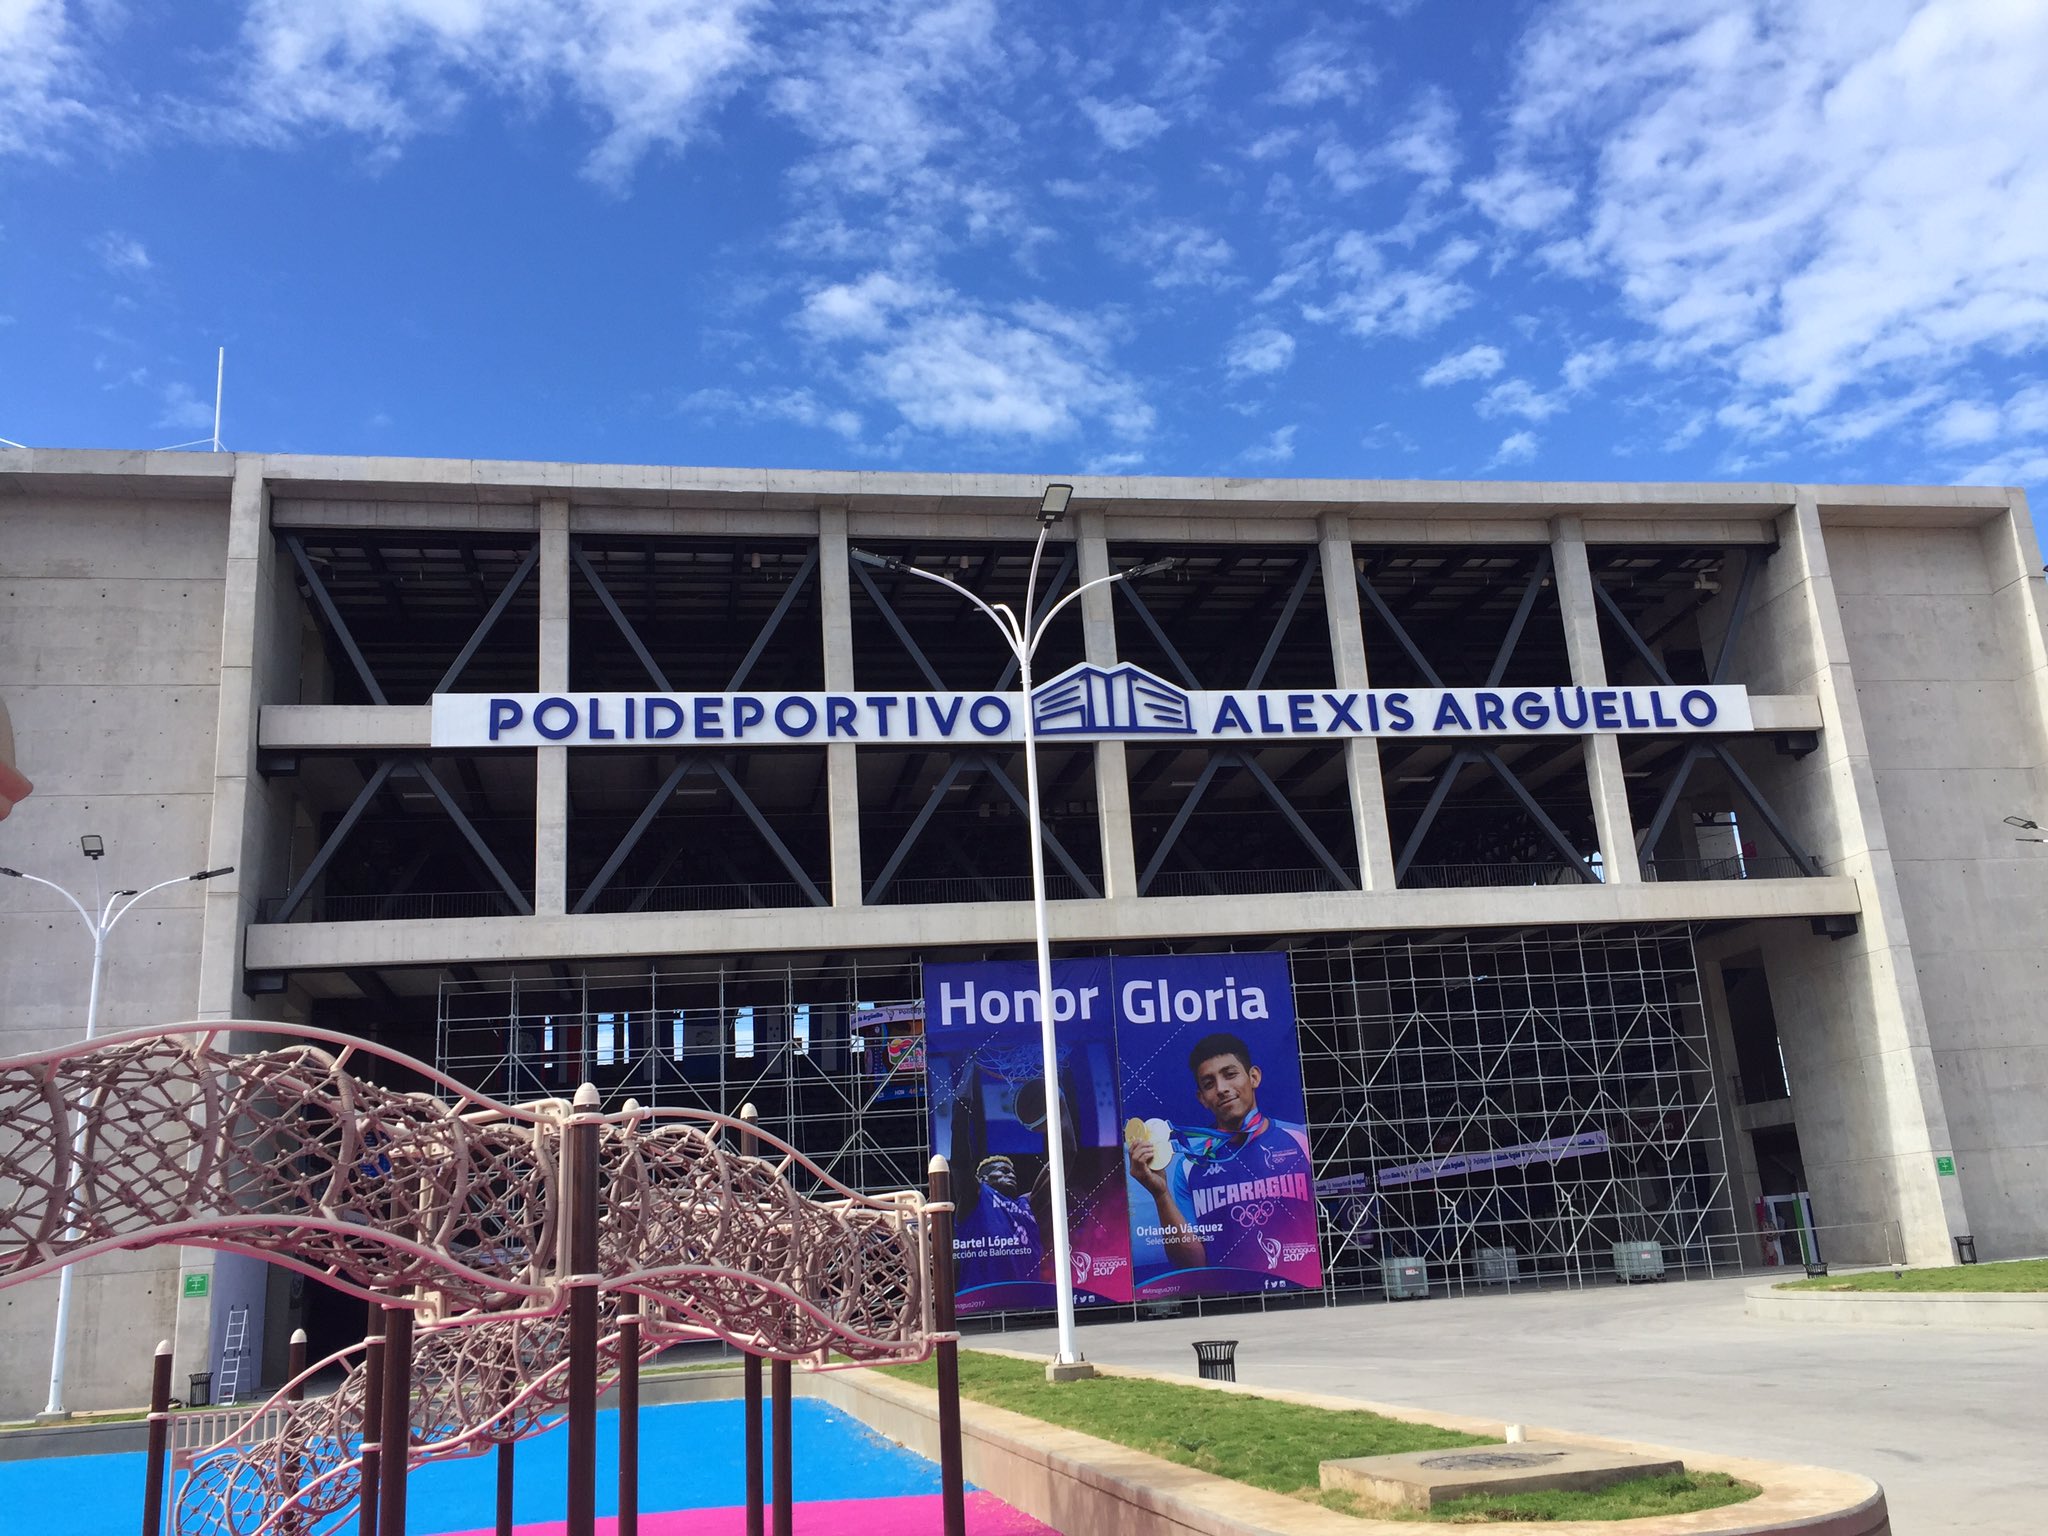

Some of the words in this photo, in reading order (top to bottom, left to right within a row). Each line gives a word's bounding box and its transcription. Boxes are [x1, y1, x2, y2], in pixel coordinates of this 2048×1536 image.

[489, 695, 1011, 741] POLIDEPORTIVO
[1211, 691, 1414, 735] ALEXIS
[1432, 686, 1717, 733] ARGÜELLO
[939, 981, 1099, 1026] Honor
[1121, 976, 1269, 1024] Gloria
[1192, 1172, 1309, 1219] NICARAGUA
[1136, 1223, 1178, 1238] Orlando
[1179, 1221, 1224, 1237] Vásquez
[953, 1235, 985, 1250] Bartel
[988, 1234, 1020, 1249] López
[1145, 1235, 1181, 1246] Selección
[1181, 1234, 1191, 1243] de
[1192, 1233, 1215, 1243] Pesas
[953, 1249, 977, 1260] ección
[978, 1248, 988, 1257] de
[989, 1246, 1032, 1257] Baloncesto
[1283, 1253, 1305, 1263] 2017
[1093, 1267, 1116, 1277] 2017
